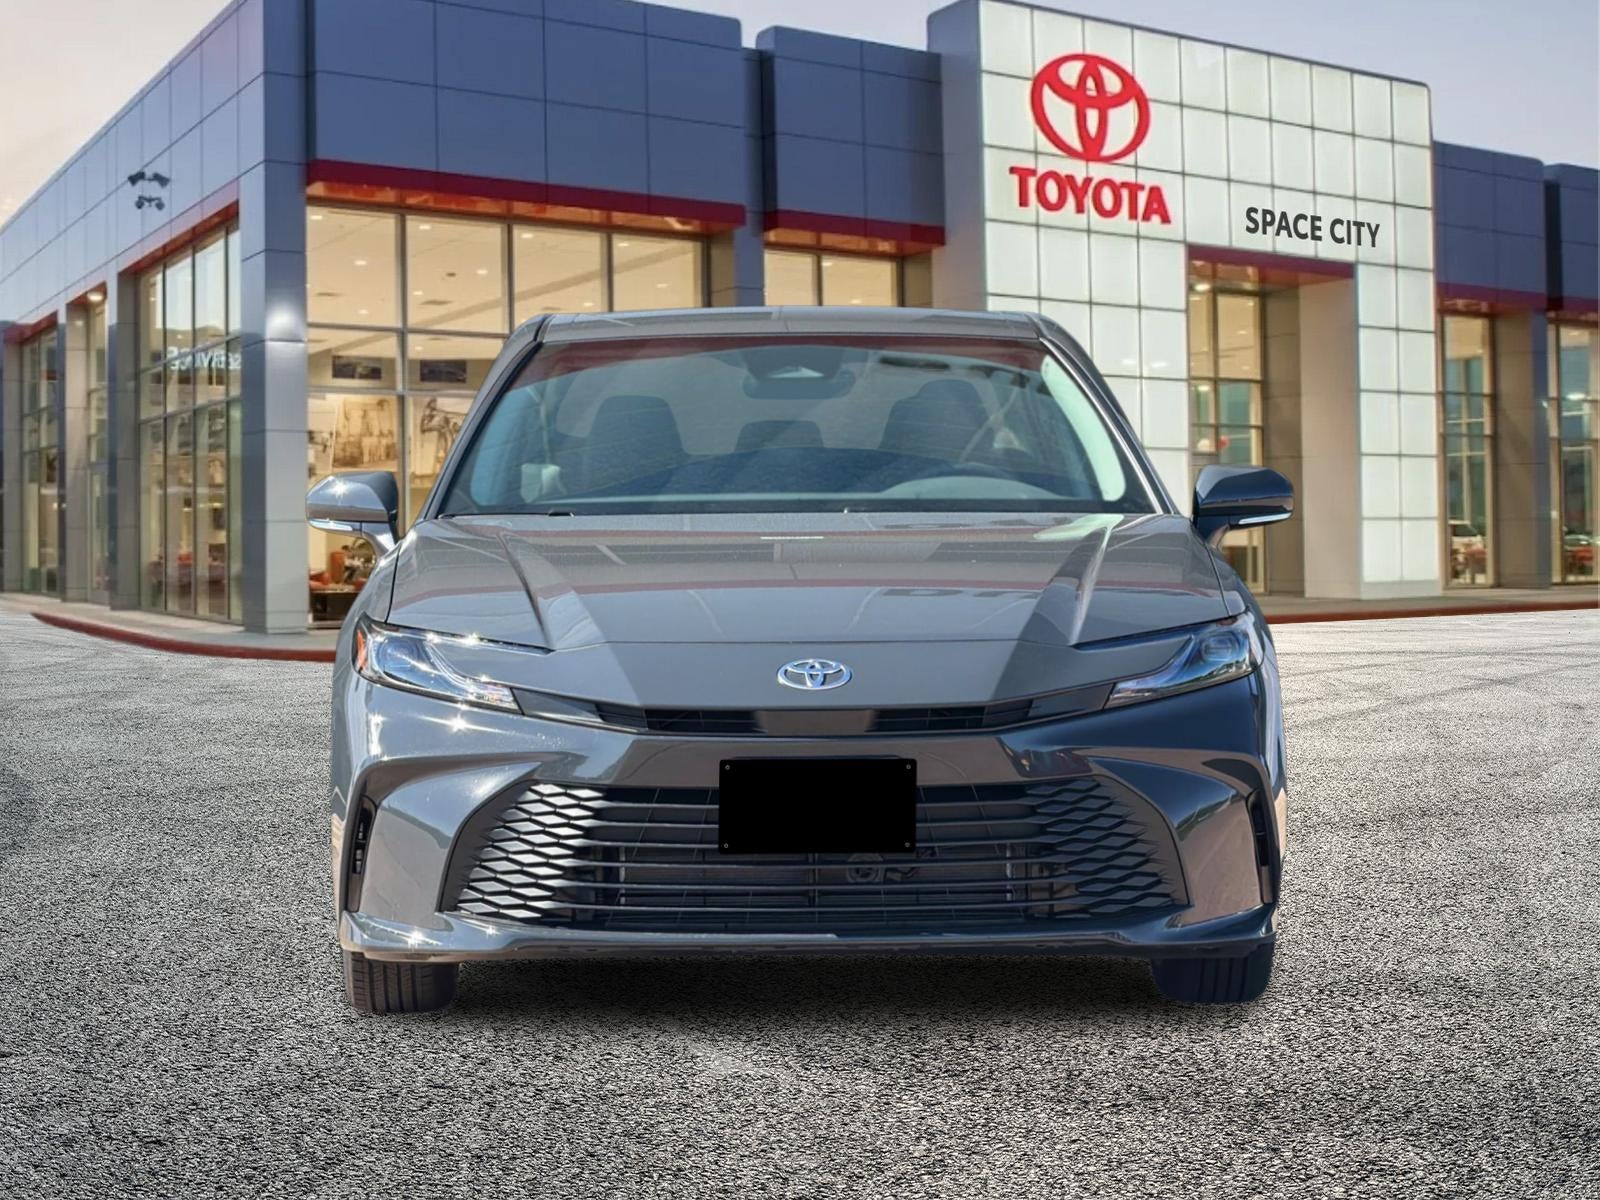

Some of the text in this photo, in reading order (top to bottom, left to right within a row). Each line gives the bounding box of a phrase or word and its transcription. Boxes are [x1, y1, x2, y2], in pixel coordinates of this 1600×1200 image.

[1009, 166, 1171, 224] TOYOTA
[1245, 206, 1380, 248] SPACE CITY
